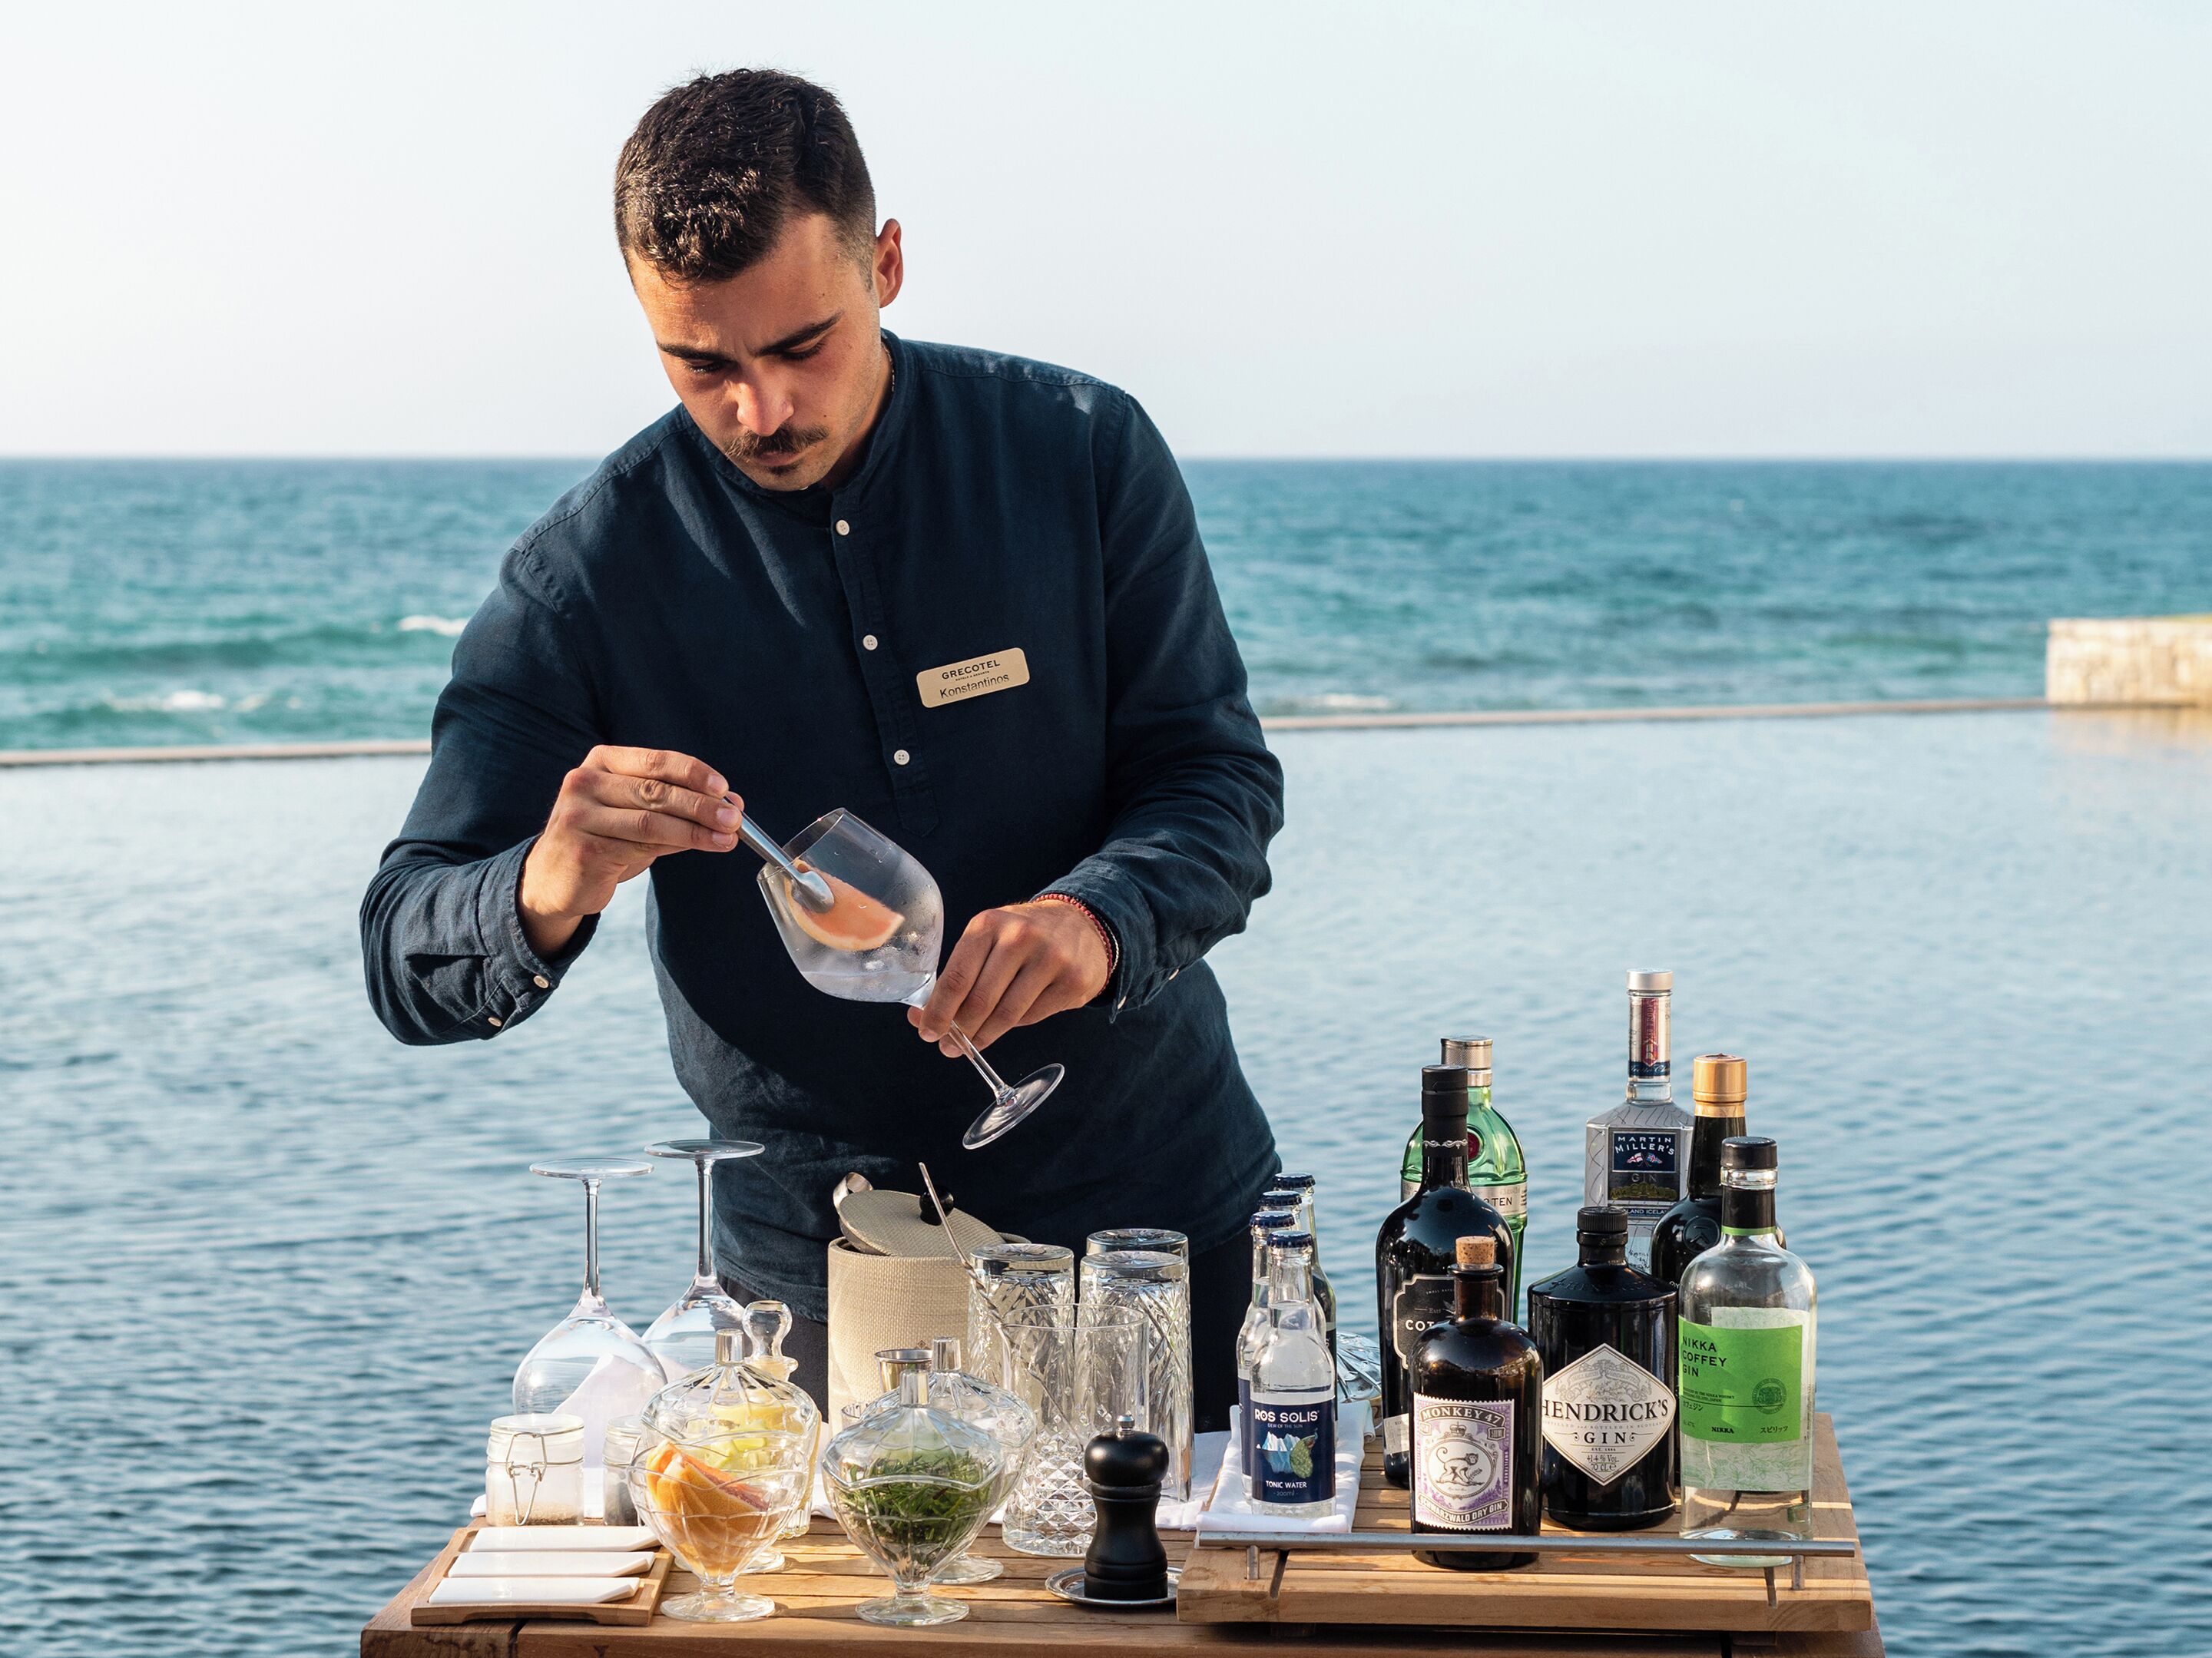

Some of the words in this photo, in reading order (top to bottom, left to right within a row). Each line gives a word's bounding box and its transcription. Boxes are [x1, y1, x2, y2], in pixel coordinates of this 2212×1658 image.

[942, 660, 1001, 680] GRECOTEL
[939, 674, 1010, 698] Konstantinos
[1614, 1143, 1675, 1156] MILLER'S
[1631, 1173, 1657, 1183] GIN
[1492, 1197, 1512, 1206] TEN
[1405, 1319, 1435, 1332] COT
[1682, 1336, 1717, 1352] NIKKA
[1682, 1350, 1727, 1367] COFFEY
[1682, 1364, 1699, 1377] GIN
[1254, 1408, 1276, 1422] ROS
[1280, 1411, 1318, 1423] SOLIS
[1422, 1406, 1484, 1420] MONKEY
[1485, 1414, 1502, 1424] 47
[1584, 1431, 1626, 1444] GIN
[1265, 1480, 1283, 1488] TONIC
[1472, 1507, 1488, 1520] DRY
[1488, 1502, 1502, 1513] GIN
